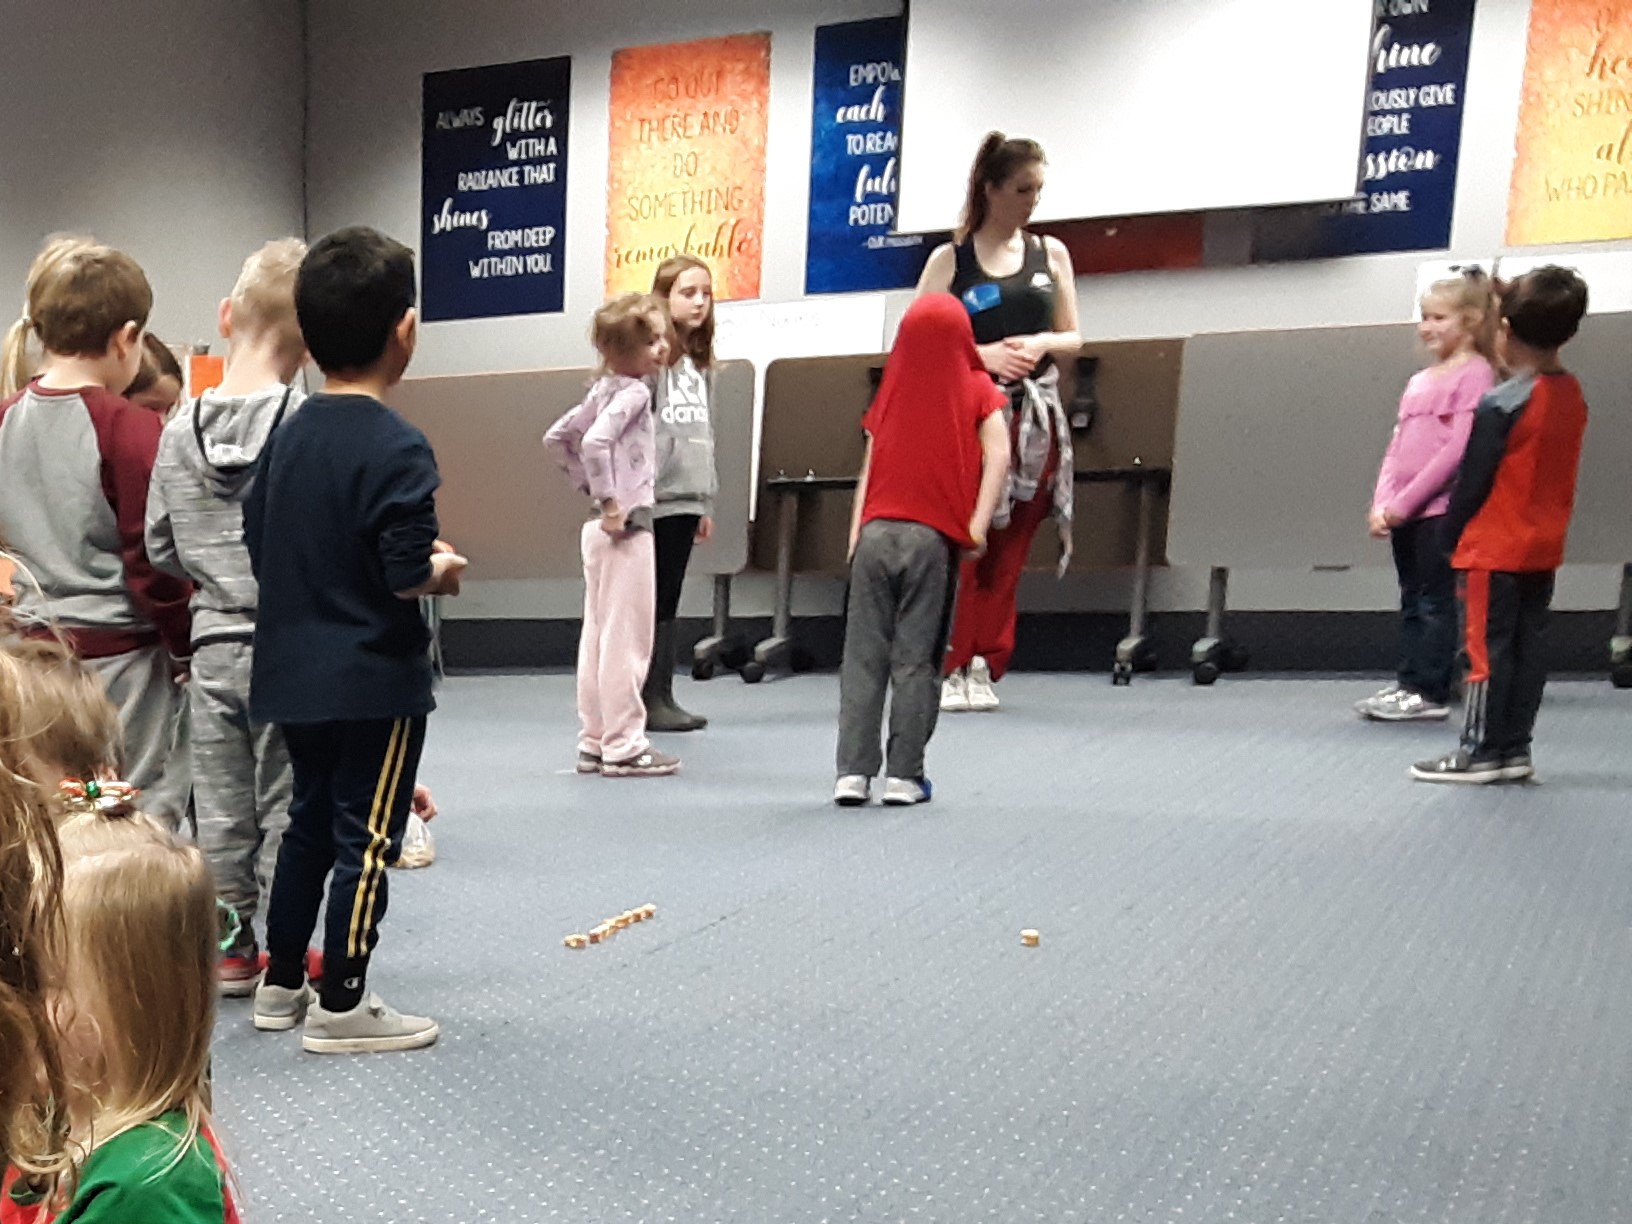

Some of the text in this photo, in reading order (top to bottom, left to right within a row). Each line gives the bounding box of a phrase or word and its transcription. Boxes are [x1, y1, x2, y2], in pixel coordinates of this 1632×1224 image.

[836, 84, 886, 123] each
[1419, 82, 1456, 107] GIVE
[436, 98, 554, 147] ALWAYS glitter
[639, 109, 739, 143] THERE AND
[506, 136, 558, 160] WITH A
[846, 133, 864, 155] TO
[458, 162, 556, 191] RADIANCE THAT
[674, 151, 698, 178] DO
[1370, 190, 1411, 213] SAME
[1545, 174, 1598, 202] WHO
[431, 197, 492, 235] shines
[628, 186, 743, 222] SOMETHING
[487, 226, 556, 251] FROM DEEP
[614, 218, 753, 269] remarkable
[469, 255, 524, 279] WITHIN
